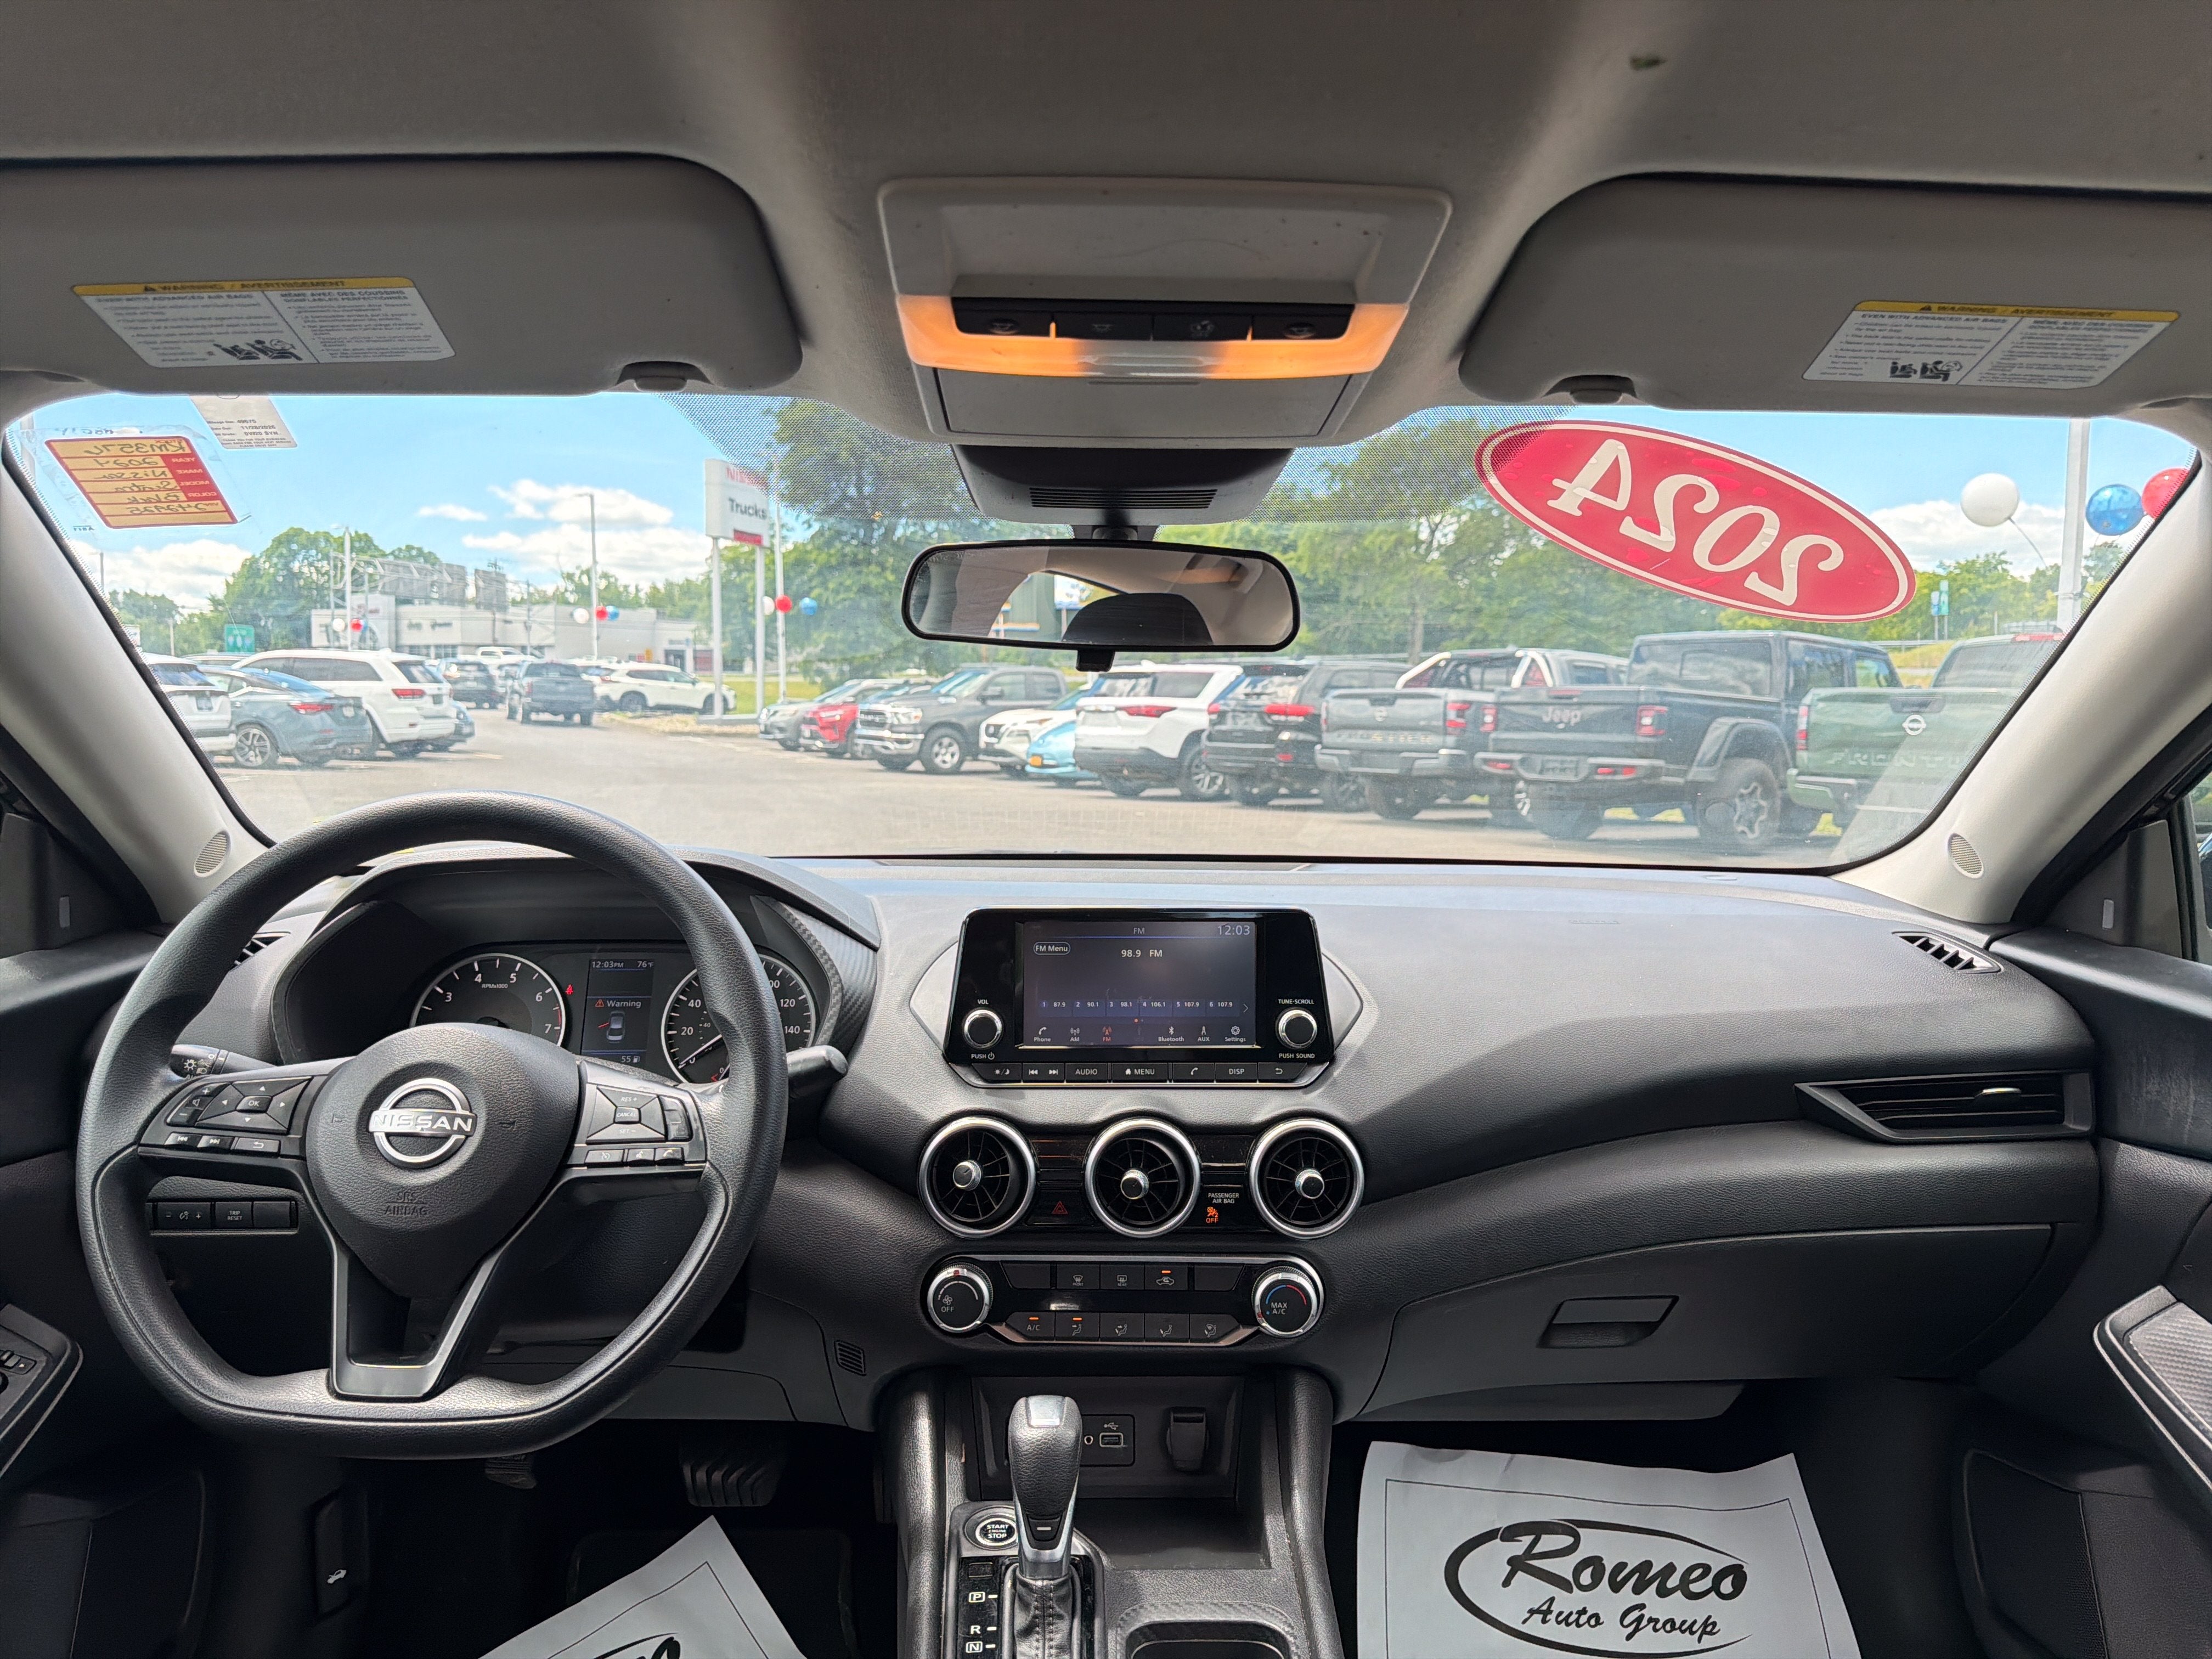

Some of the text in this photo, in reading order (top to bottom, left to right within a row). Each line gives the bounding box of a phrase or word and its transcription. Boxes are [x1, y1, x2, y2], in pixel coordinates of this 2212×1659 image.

[728, 497, 768, 520] Trucks
[1542, 706, 1583, 727] Jeep
[1217, 925, 1250, 935] 12:03
[1121, 949, 1163, 957] 98.9 FM
[474, 973, 482, 983] 4
[509, 973, 517, 983] 5
[445, 992, 452, 1002] 3
[535, 992, 543, 1002] 6
[607, 1000, 641, 1009] Warning
[688, 999, 701, 1008] 40
[780, 998, 795, 1008] 120
[545, 1024, 552, 1034] 7
[681, 1026, 693, 1036] 20
[785, 1025, 800, 1035] 140
[1075, 1067, 1098, 1076] AUDIO
[373, 1114, 473, 1132] NISSAN
[394, 1191, 417, 1203] SRS
[383, 1204, 430, 1216] AIRBAG
[1499, 1520, 1748, 1601] Romeo
[1521, 1595, 1721, 1643] Auto Group
[970, 1625, 981, 1634] R
